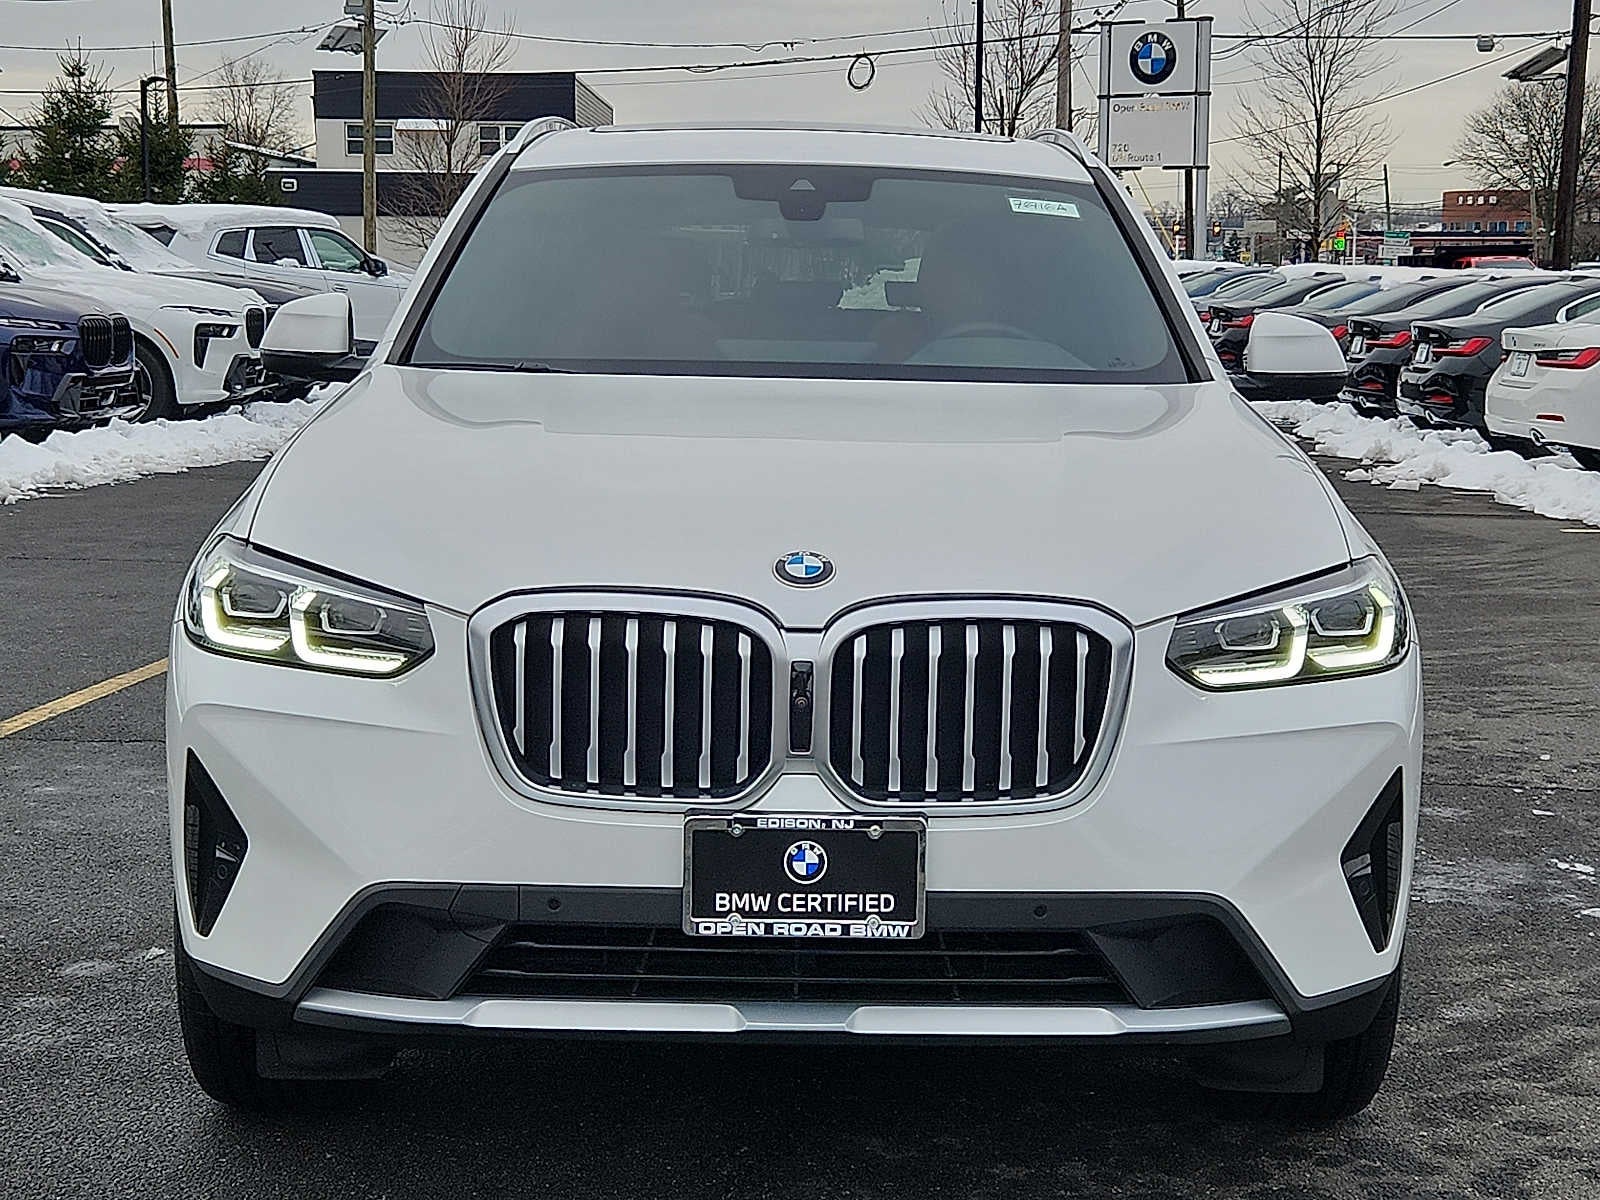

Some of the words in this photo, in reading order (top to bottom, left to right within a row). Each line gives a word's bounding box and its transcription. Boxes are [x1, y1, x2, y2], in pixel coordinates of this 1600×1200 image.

[1134, 33, 1173, 51] BMW
[831, 819, 855, 829] NJ
[715, 893, 770, 912] BMW
[777, 894, 895, 913] CERTIFIED
[698, 922, 766, 936] OPEN
[773, 923, 842, 937] ROAD
[851, 923, 910, 937] BMW
